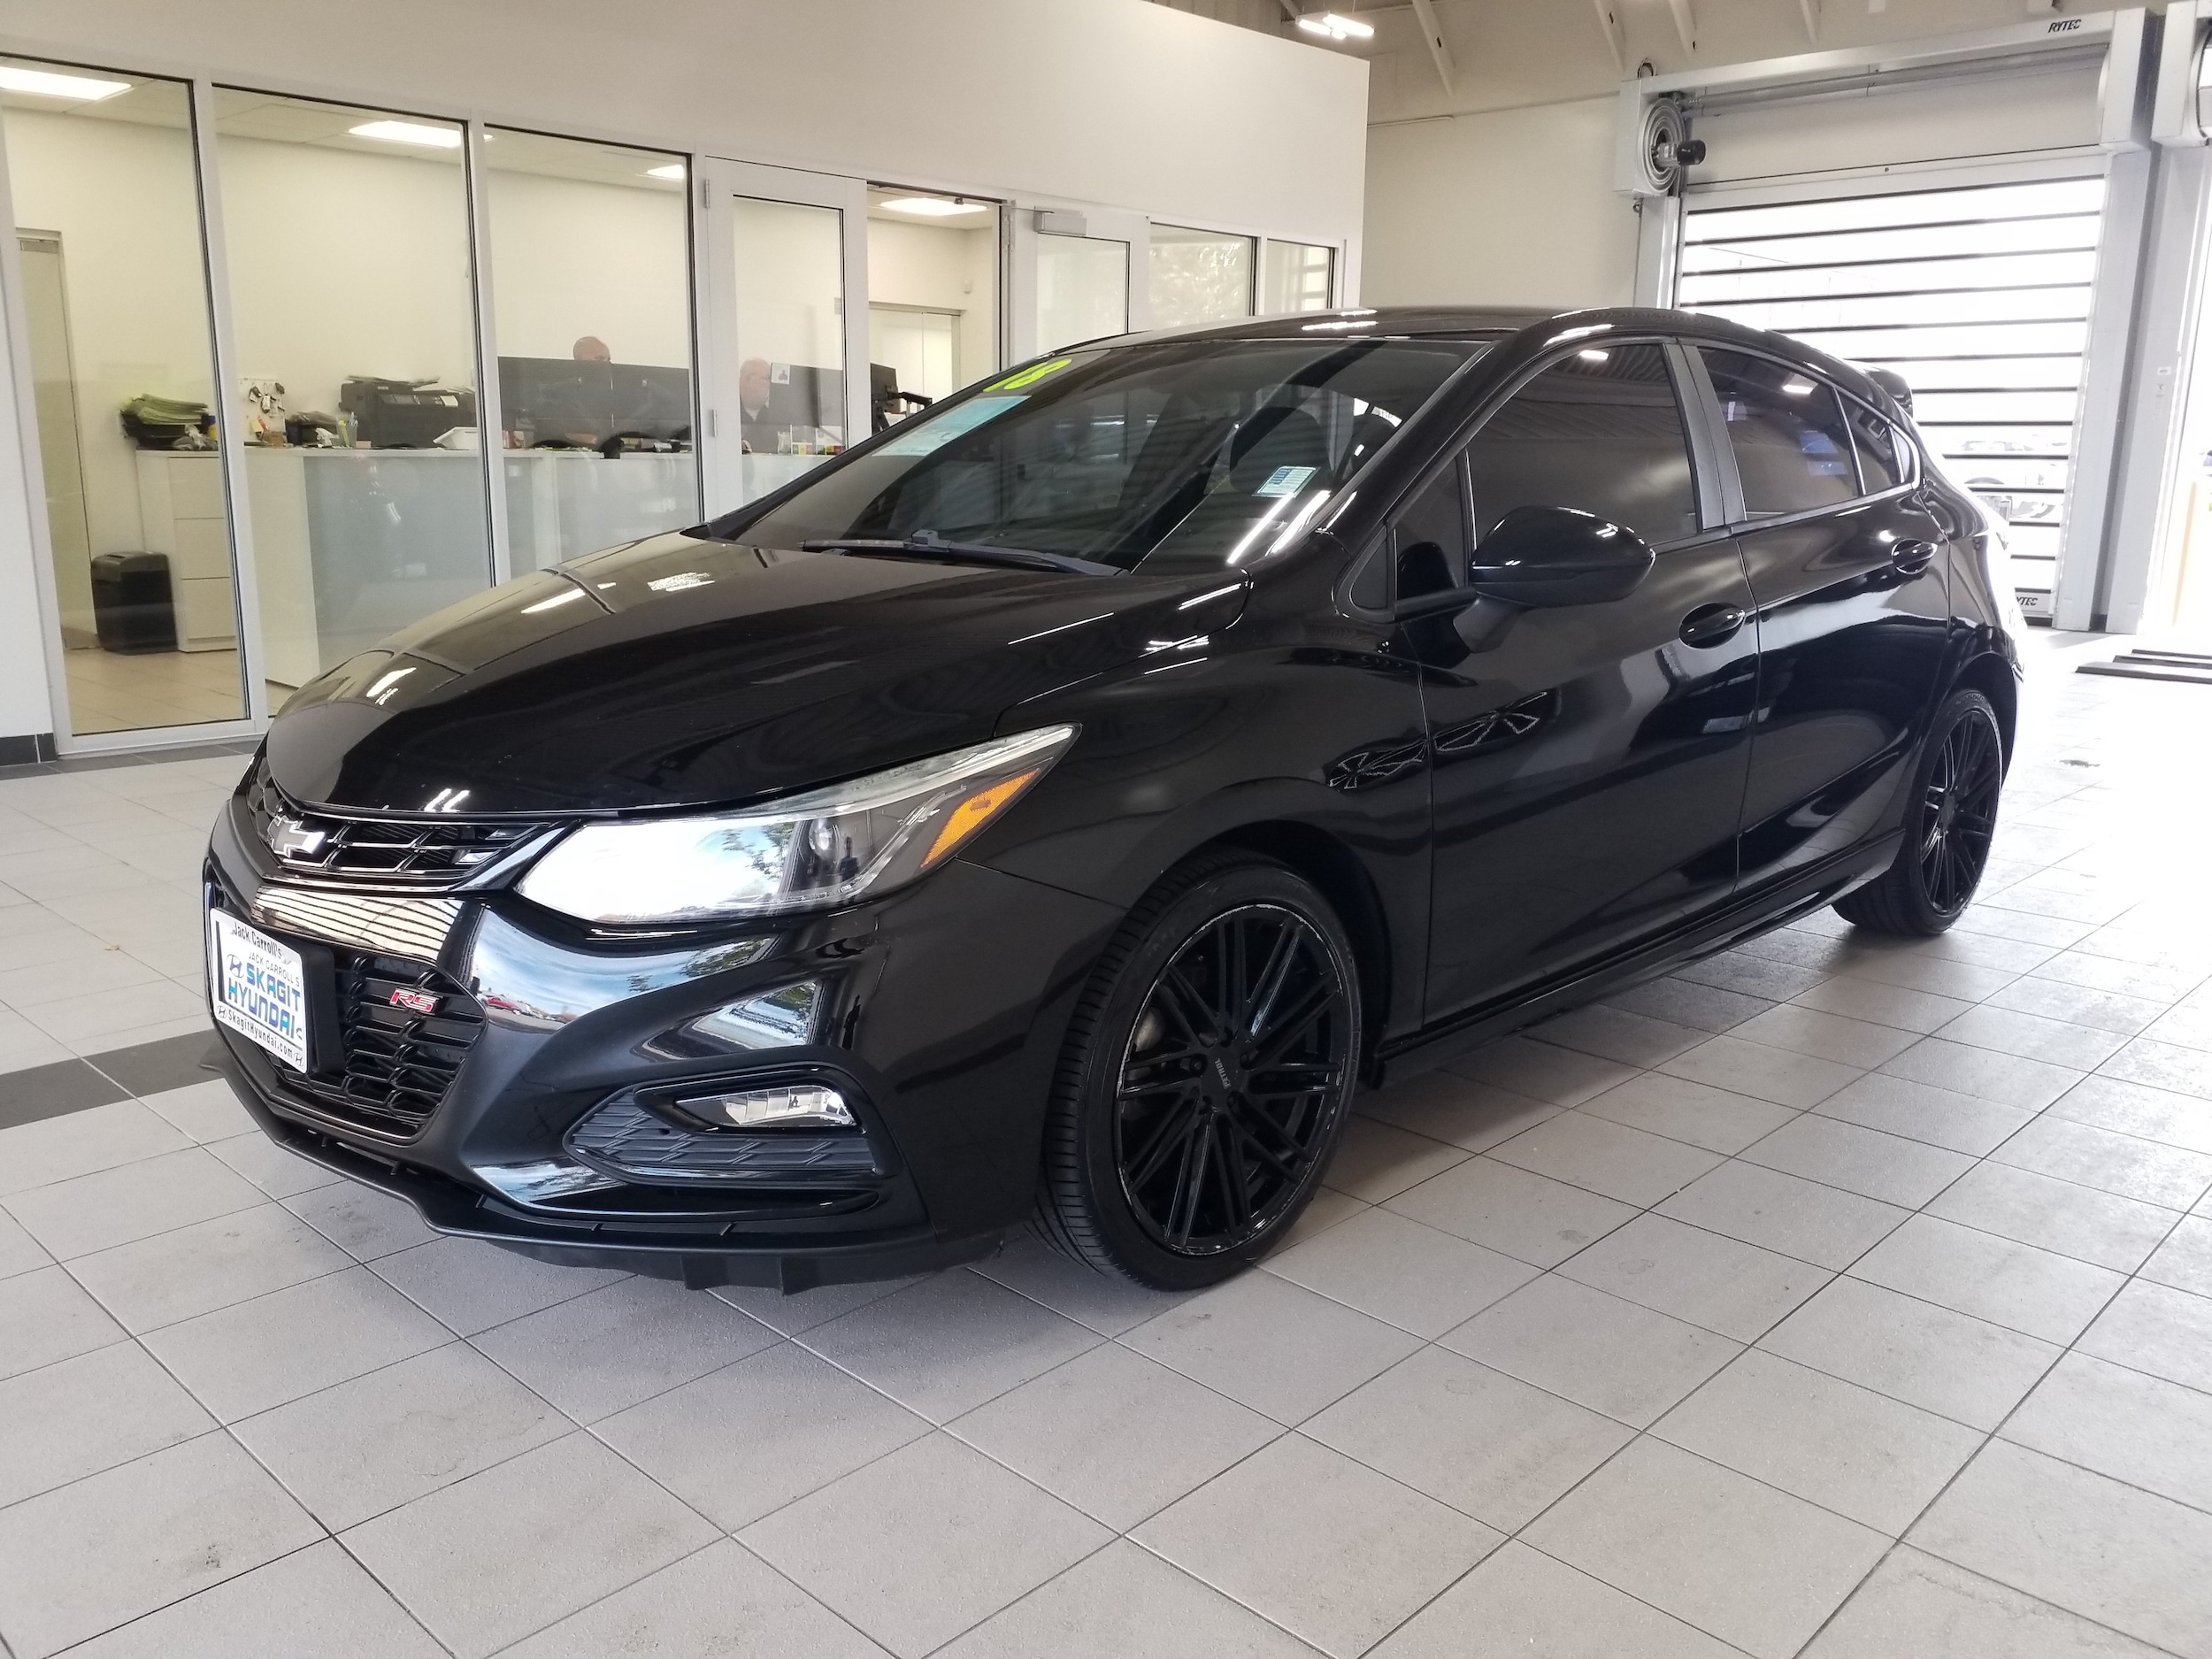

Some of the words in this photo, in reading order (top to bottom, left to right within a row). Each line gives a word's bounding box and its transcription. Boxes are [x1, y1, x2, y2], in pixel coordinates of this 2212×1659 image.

[2048, 19, 2082, 33] RYTEC
[2016, 596, 2039, 606] YTEC
[232, 922, 252, 942] Jack
[251, 931, 282, 960] Carroll's
[246, 962, 301, 1012] SKAGIT
[249, 951, 264, 965] JACK
[265, 959, 300, 987] CARROLLS
[228, 978, 296, 1040] HYUNDAI
[390, 988, 439, 1013] RS
[227, 1009, 294, 1059] SkagitHyundai.com
